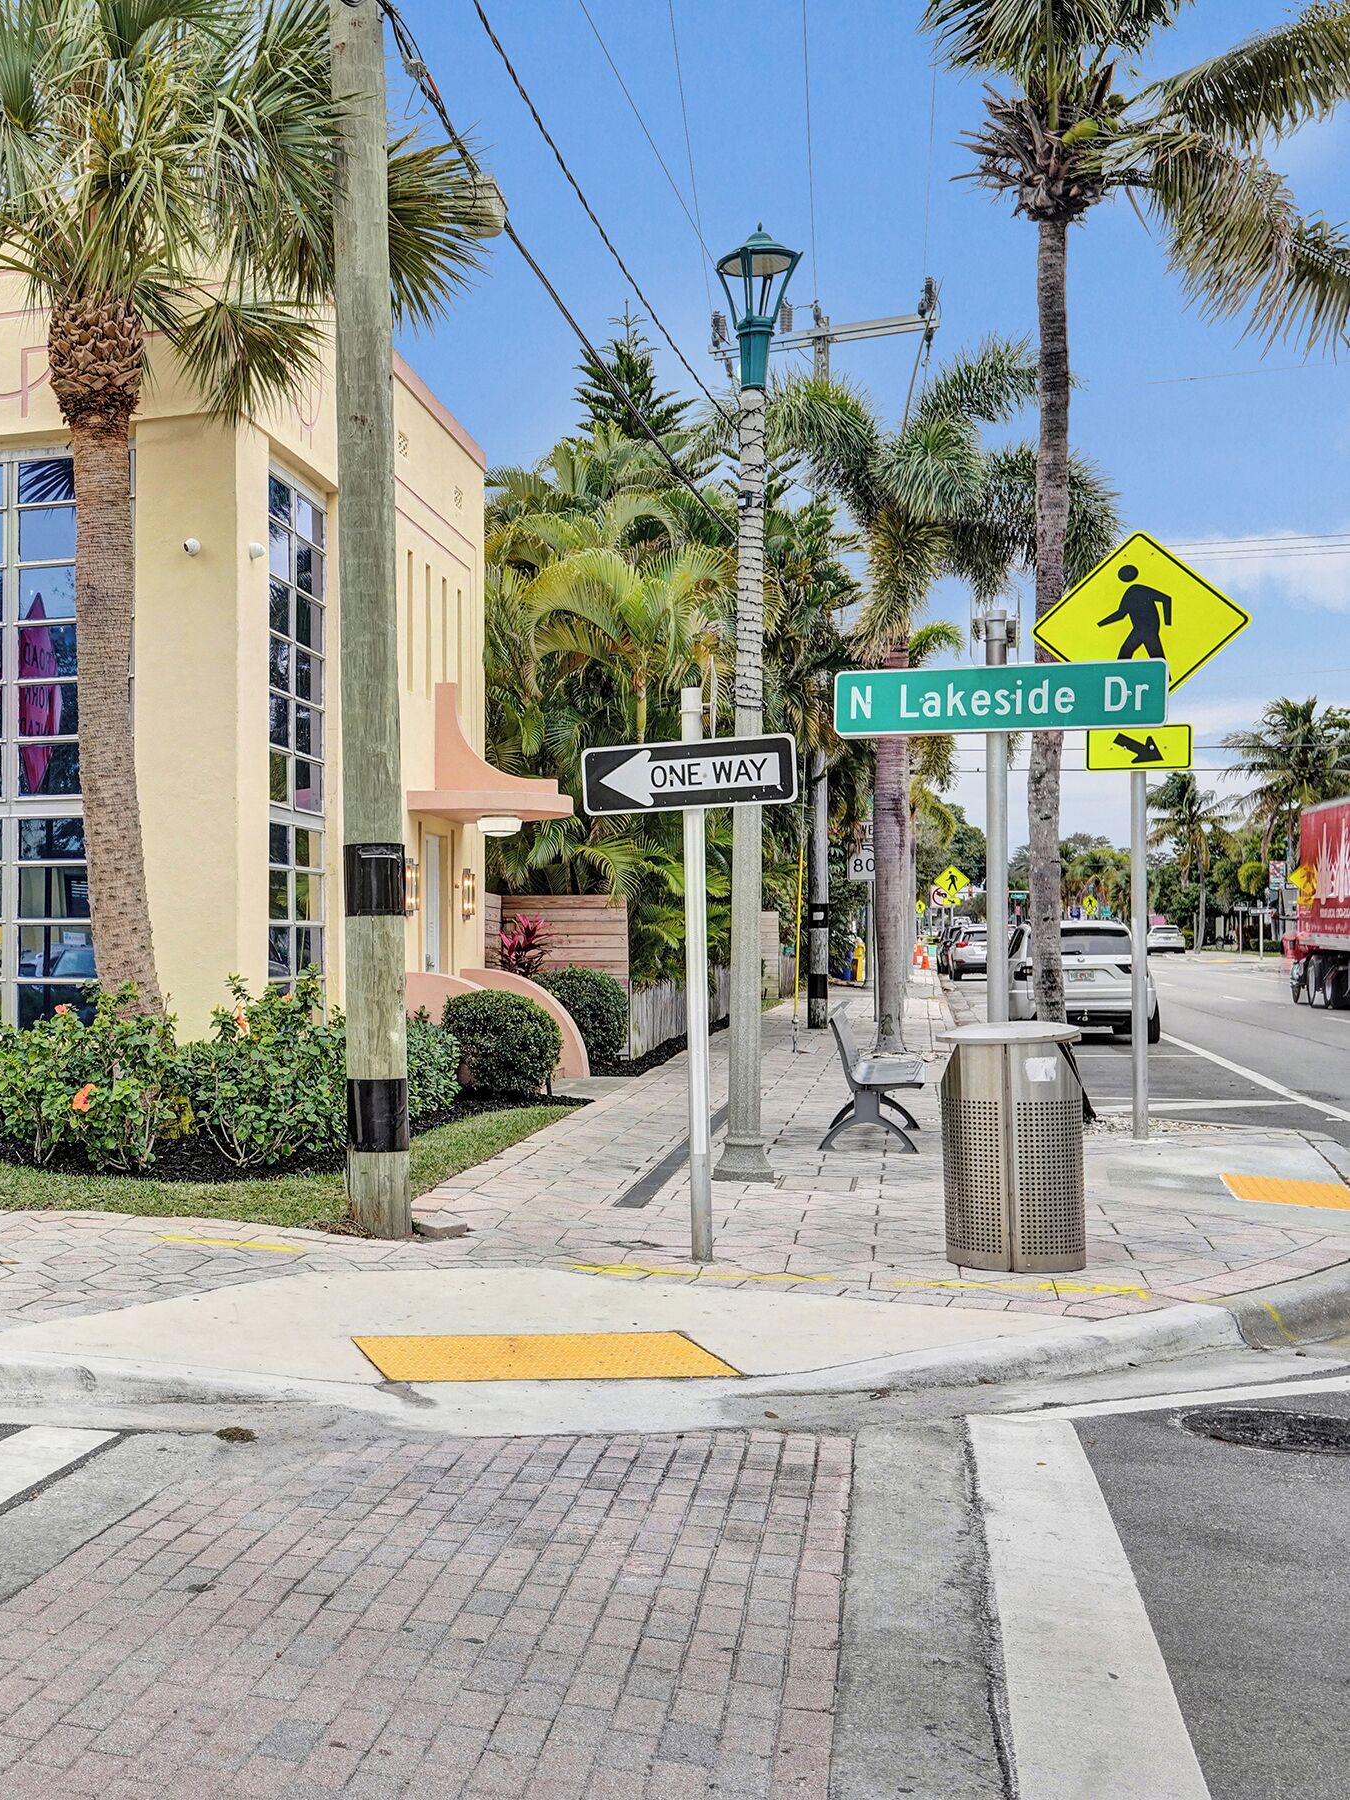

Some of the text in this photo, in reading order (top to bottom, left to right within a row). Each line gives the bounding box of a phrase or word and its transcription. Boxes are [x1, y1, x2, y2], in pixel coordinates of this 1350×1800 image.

[850, 676, 1149, 719] N Lakeside Dr
[651, 758, 768, 788] ONE WAY
